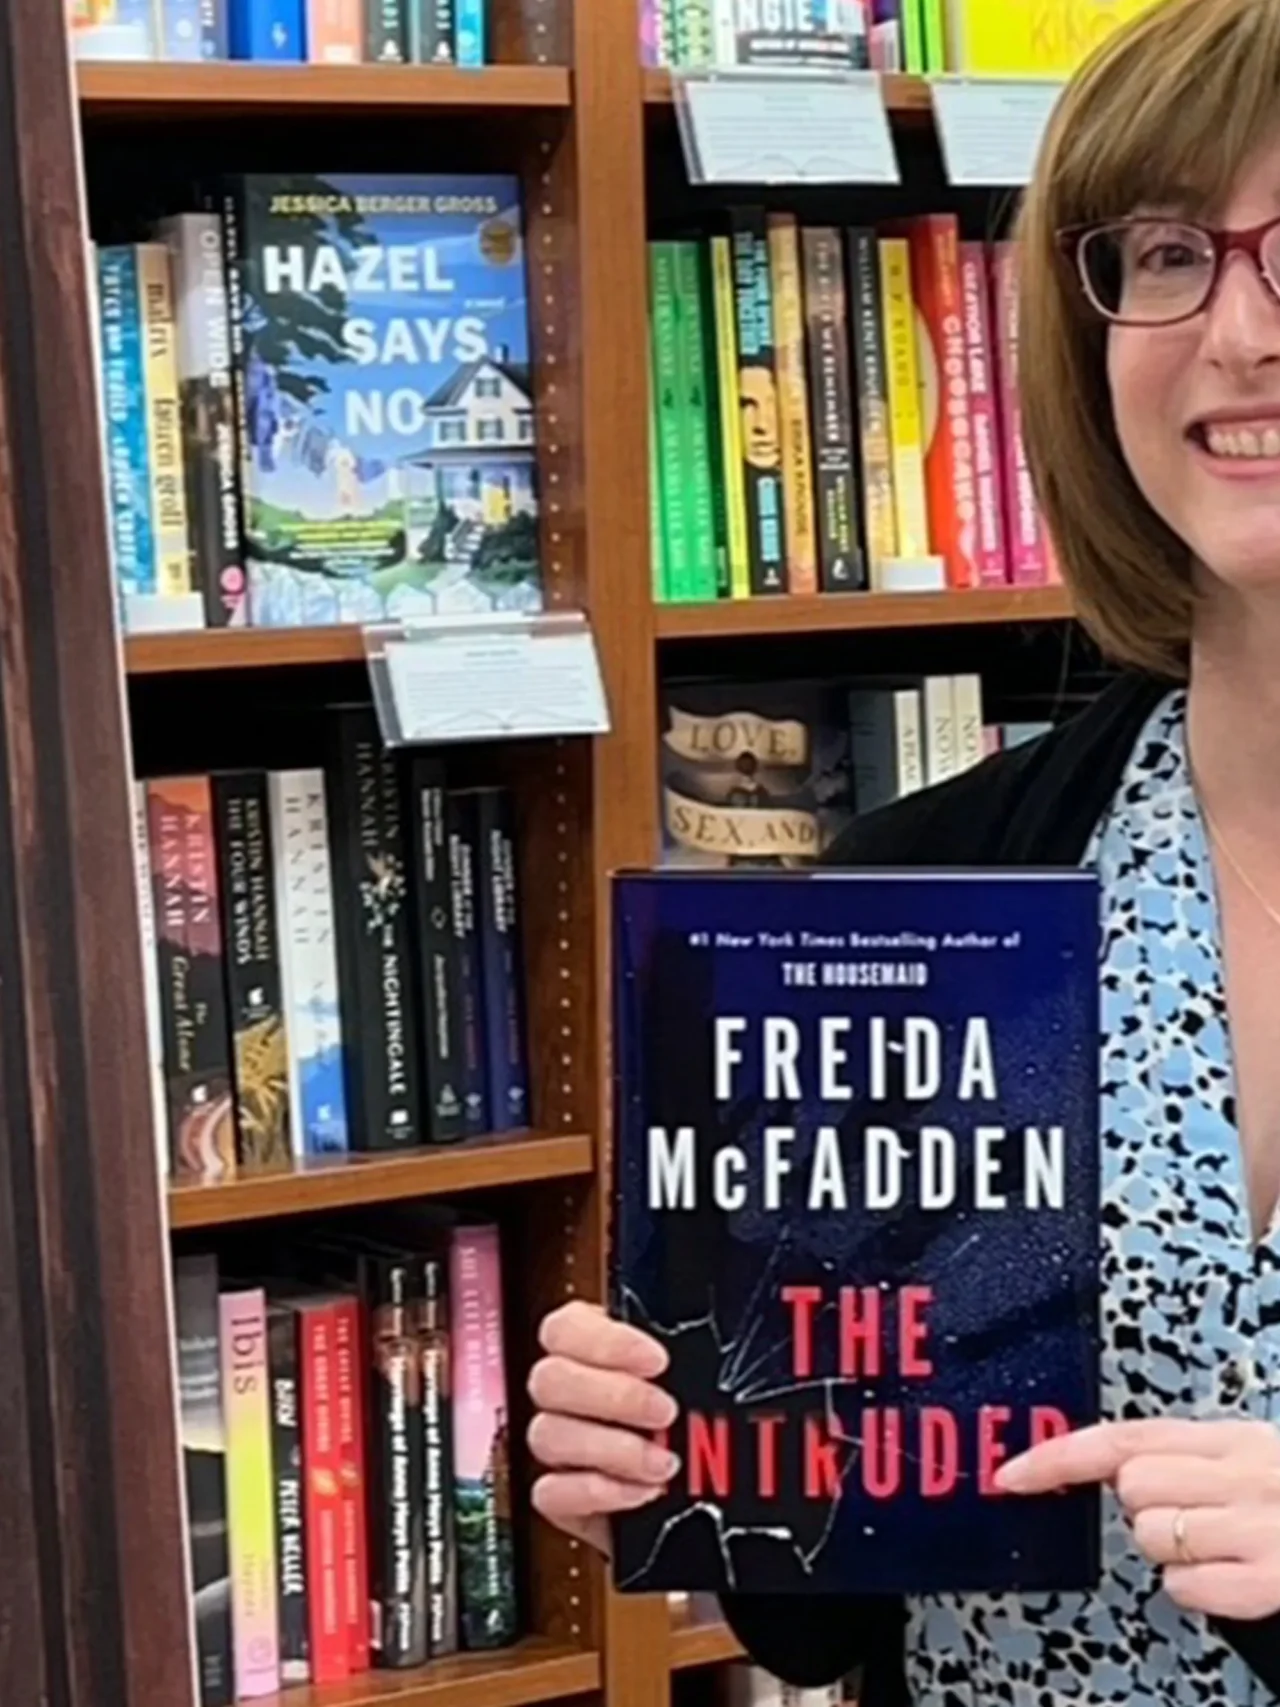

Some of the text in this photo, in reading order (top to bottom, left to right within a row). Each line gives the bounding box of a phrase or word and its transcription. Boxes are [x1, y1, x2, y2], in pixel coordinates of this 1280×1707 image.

[270, 195, 497, 213] JESSICA BERGER GROSS
[263, 245, 455, 293] HAZEL
[148, 283, 173, 359] matrix
[199, 230, 230, 388] OPEN WIDE
[342, 316, 488, 365] SAYS
[861, 310, 874, 350] KENT
[823, 356, 840, 442] REMEMBER
[863, 355, 880, 433] KRUEGER
[968, 347, 986, 393] LAKE
[345, 388, 426, 436] NO
[221, 494, 237, 549] GROSS
[355, 742, 381, 847] HANNAH
[760, 820, 814, 844] AND
[160, 815, 185, 927] HANNAH
[185, 813, 211, 924] KRISTIN
[227, 798, 251, 964] THE FOUR WINDS
[245, 798, 270, 961] KRISTIN HANNAH
[285, 796, 307, 945] HANNAH
[306, 792, 328, 945] KRISTIN
[716, 933, 752, 947] New
[758, 932, 794, 947] York
[800, 932, 845, 947] Times
[850, 932, 937, 950] Bestselling
[942, 932, 998, 947] Author
[1002, 932, 1021, 947] of
[782, 962, 927, 986] THE HOUSEMAID
[170, 956, 195, 1073] Great Alone
[382, 954, 406, 1095] NIGHTINGALE
[713, 1016, 998, 1101] FREIDA
[648, 1125, 1066, 1210] McFADDEN
[231, 1314, 263, 1395] Ibis
[312, 1324, 327, 1351] THE
[337, 1317, 351, 1343] THE
[781, 1285, 935, 1378] THE
[274, 1378, 297, 1428] BURN
[389, 1356, 409, 1432] Marriage
[423, 1349, 442, 1425] Marriage
[391, 1435, 407, 1452] of
[426, 1427, 441, 1445] of
[664, 1405, 1072, 1497] NTRUDE
[278, 1479, 304, 1596] PETER HELLER
